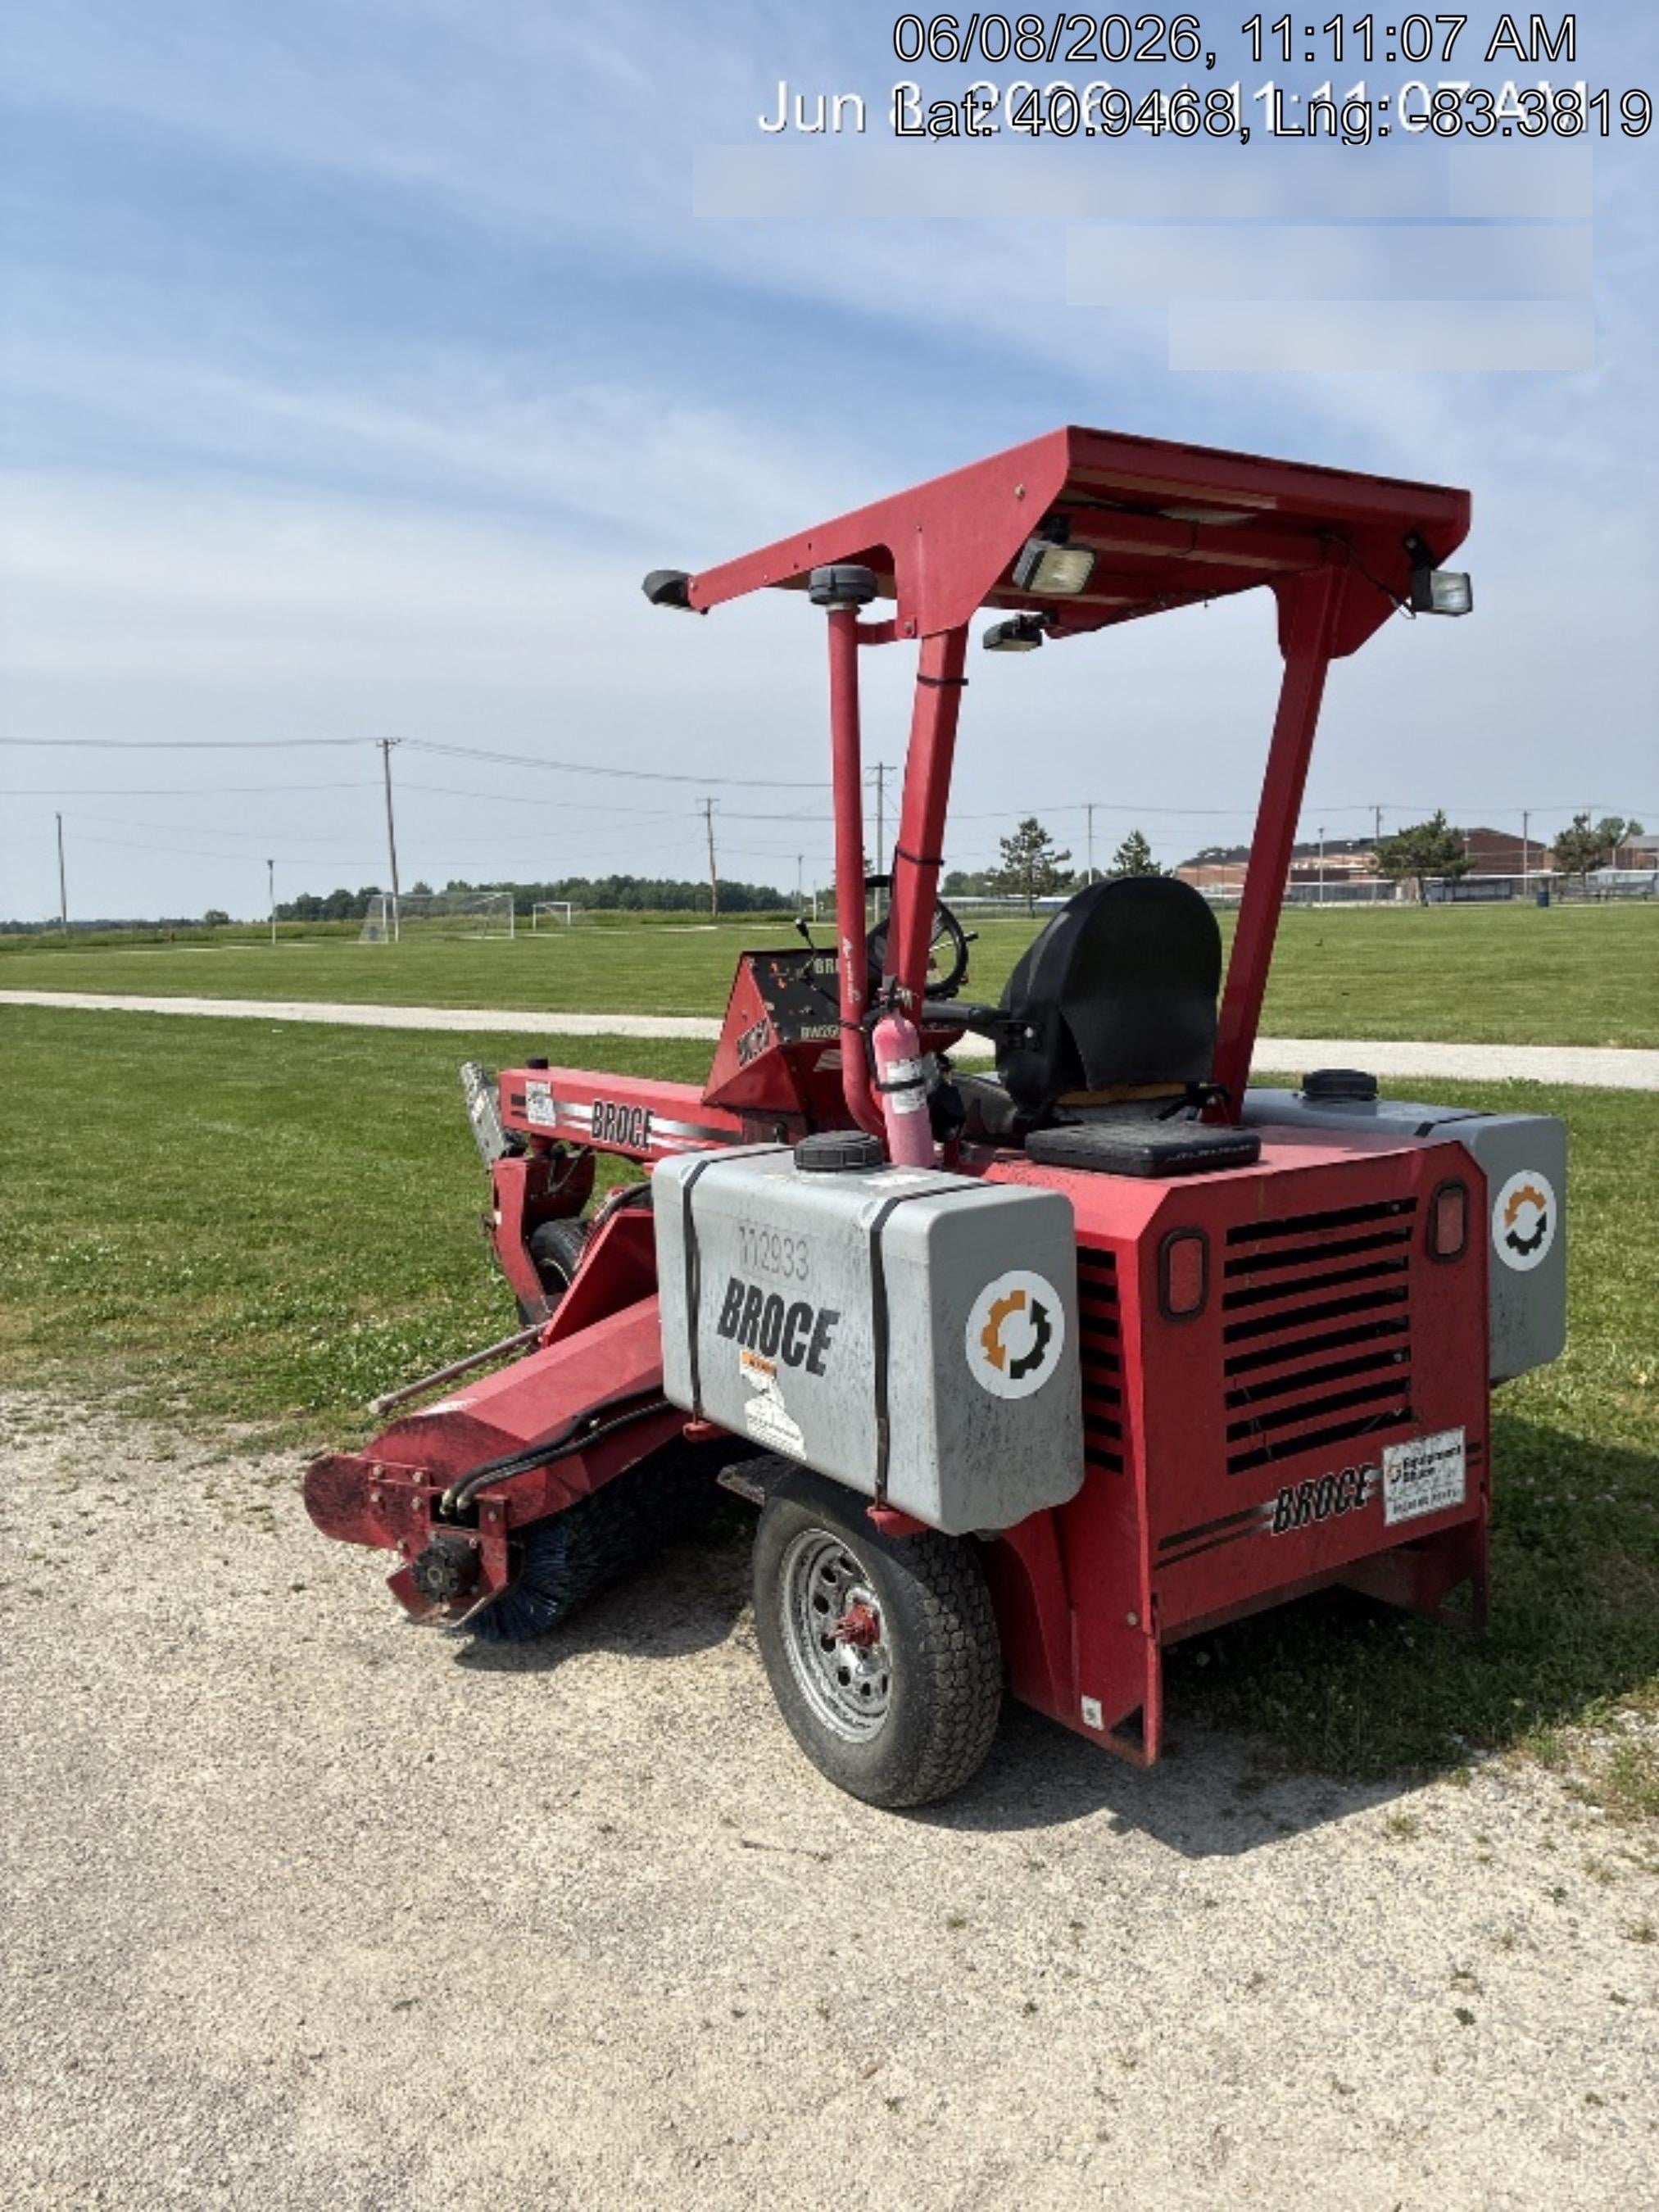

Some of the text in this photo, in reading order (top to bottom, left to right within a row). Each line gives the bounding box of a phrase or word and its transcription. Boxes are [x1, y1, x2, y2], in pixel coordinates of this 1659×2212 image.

[592, 1099, 655, 1153] BROCE
[739, 1226, 810, 1281] 112933
[717, 1275, 841, 1377] BROCE
[1271, 1462, 1375, 1536] BROCE
